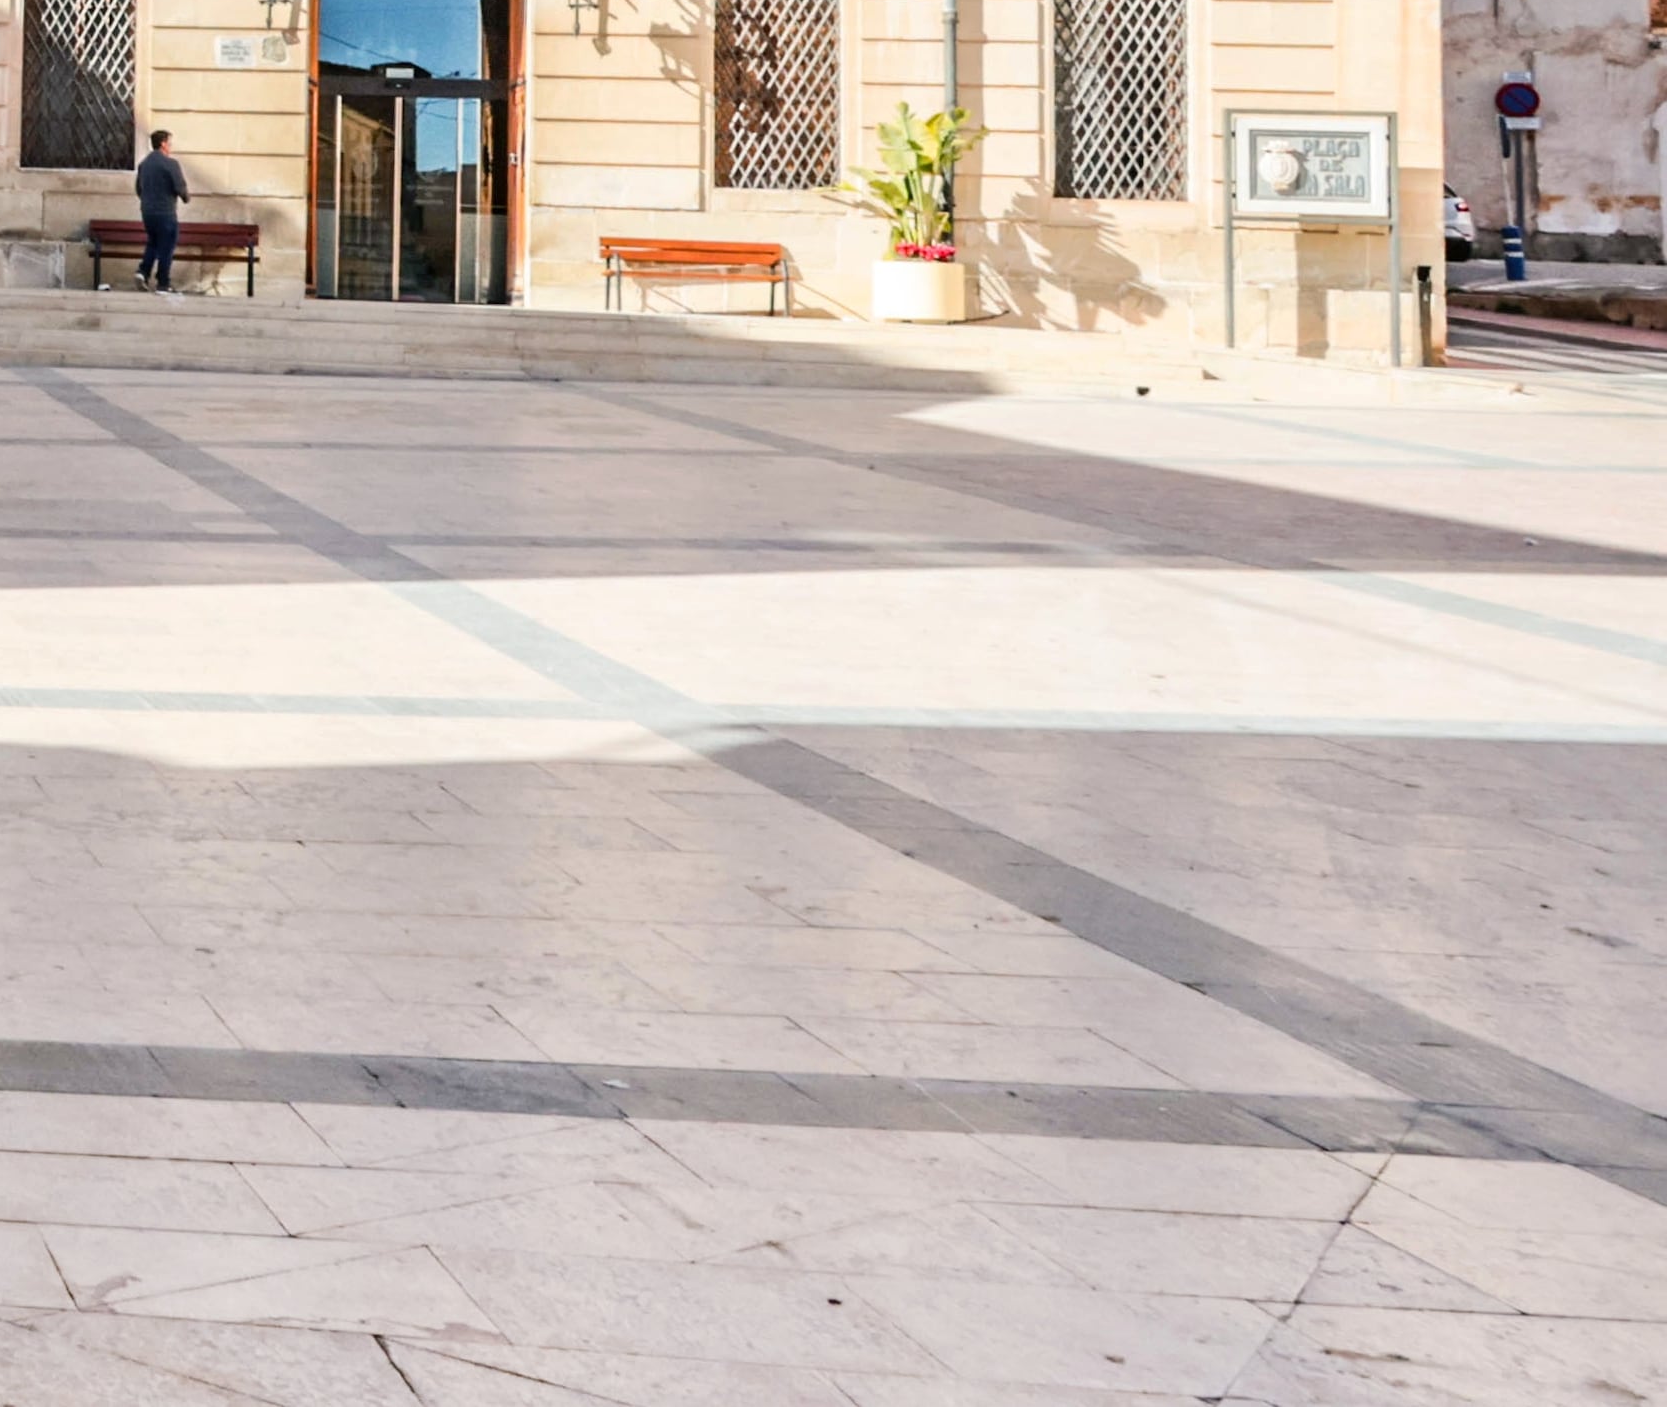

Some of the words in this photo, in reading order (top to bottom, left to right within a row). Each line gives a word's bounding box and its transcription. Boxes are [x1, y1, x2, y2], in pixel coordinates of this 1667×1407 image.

[1303, 139, 1360, 161] PLAÇA
[1319, 159, 1344, 172] DE
[1324, 174, 1365, 197] SALA
